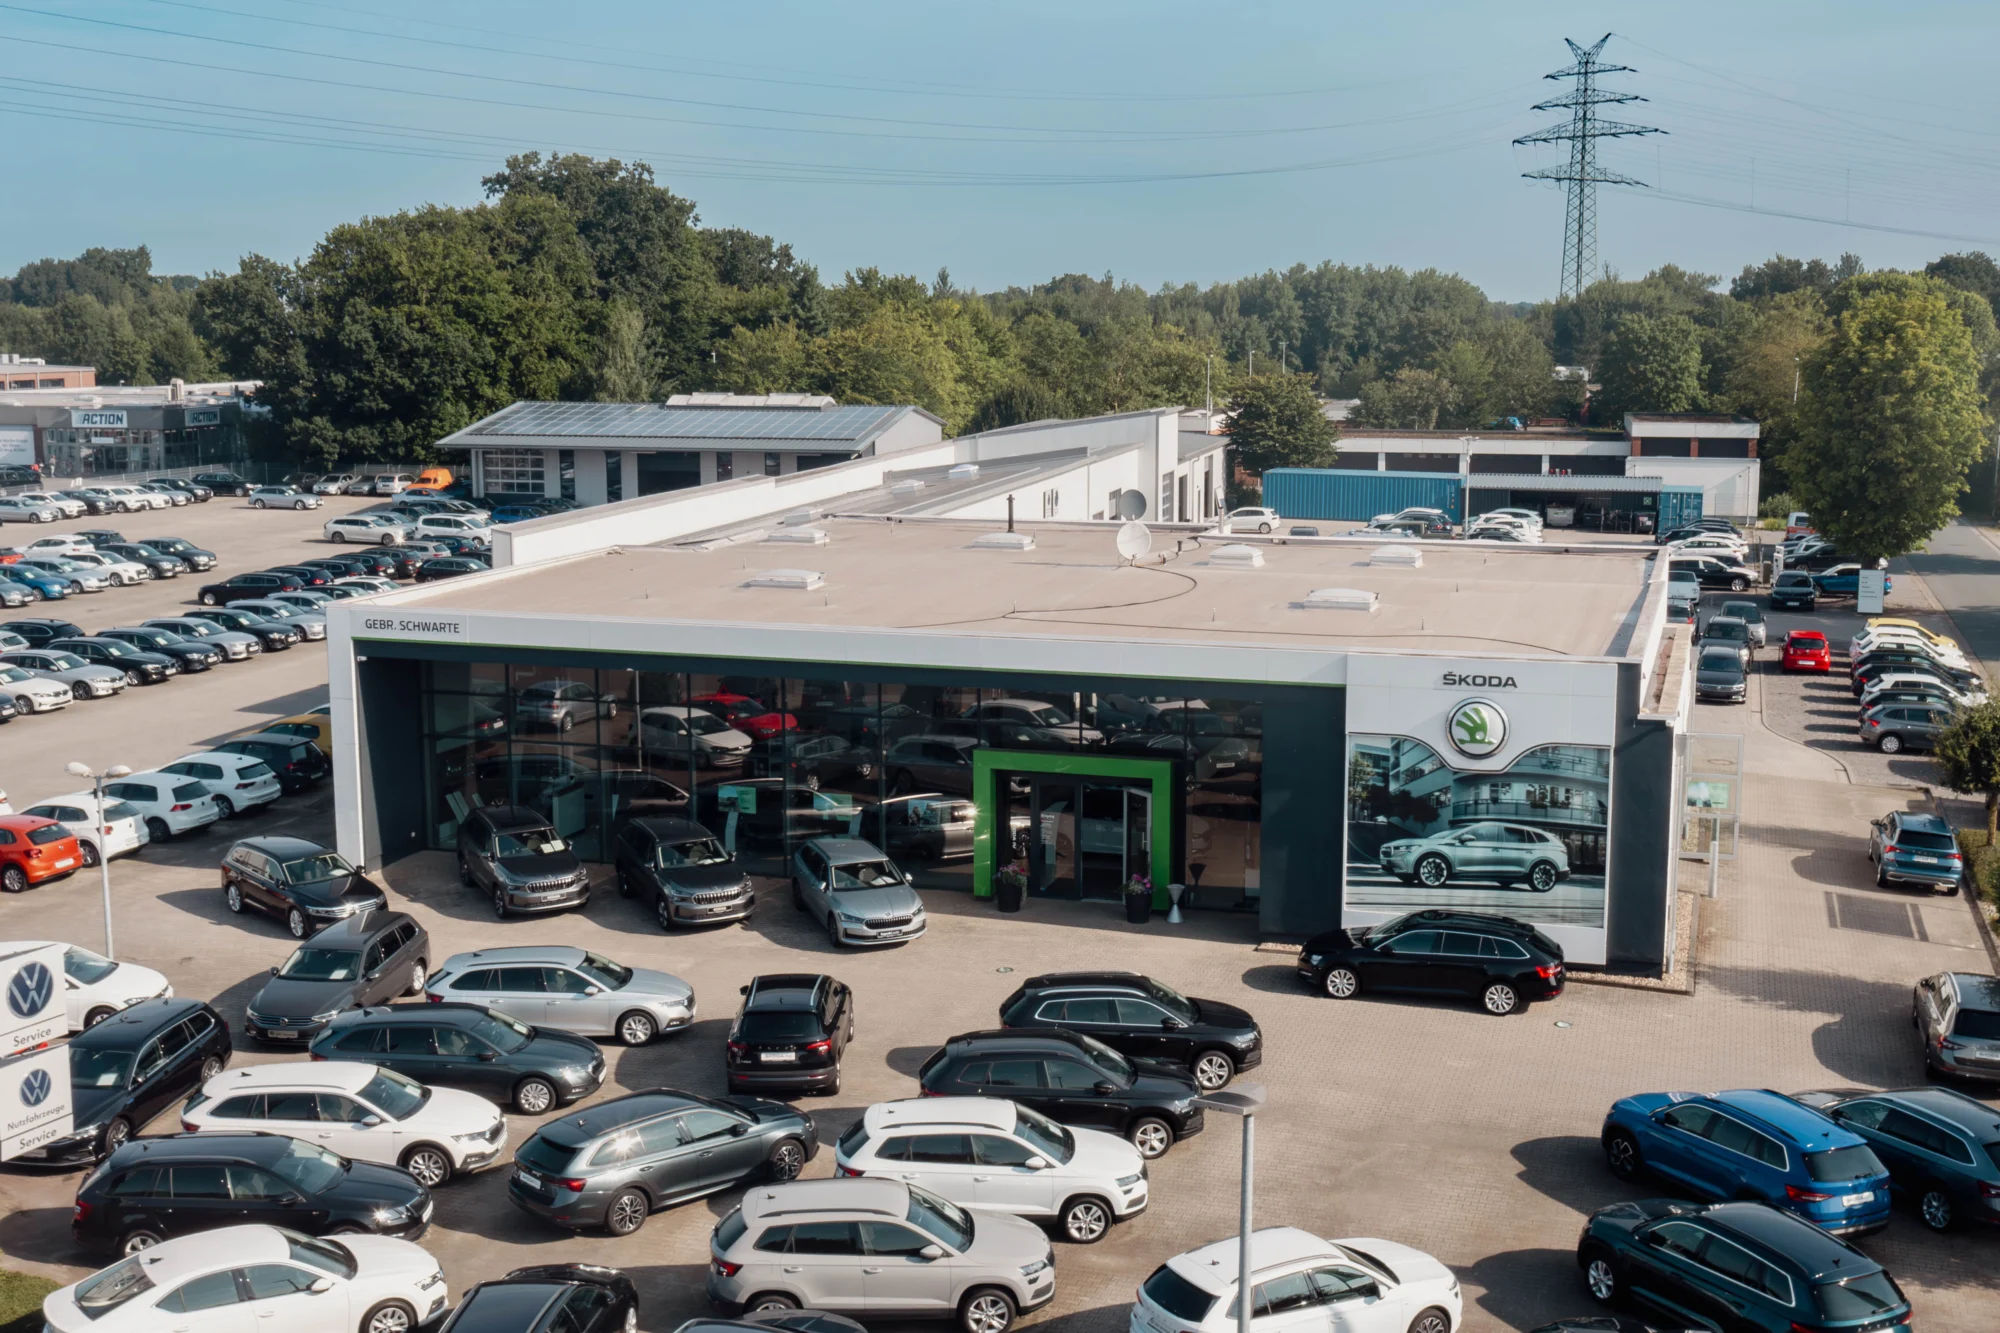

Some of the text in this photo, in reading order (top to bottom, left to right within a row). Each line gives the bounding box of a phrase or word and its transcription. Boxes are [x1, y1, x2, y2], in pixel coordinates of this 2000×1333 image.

[82, 413, 124, 425] ACTION
[192, 412, 217, 424] ACTION
[365, 618, 460, 633] GEBR. SCHWARTE
[1442, 671, 1518, 688] ŠKODA
[13, 1027, 52, 1047] Service
[7, 1104, 65, 1131] Nutzfahrzeuge
[19, 1128, 57, 1150] Service
